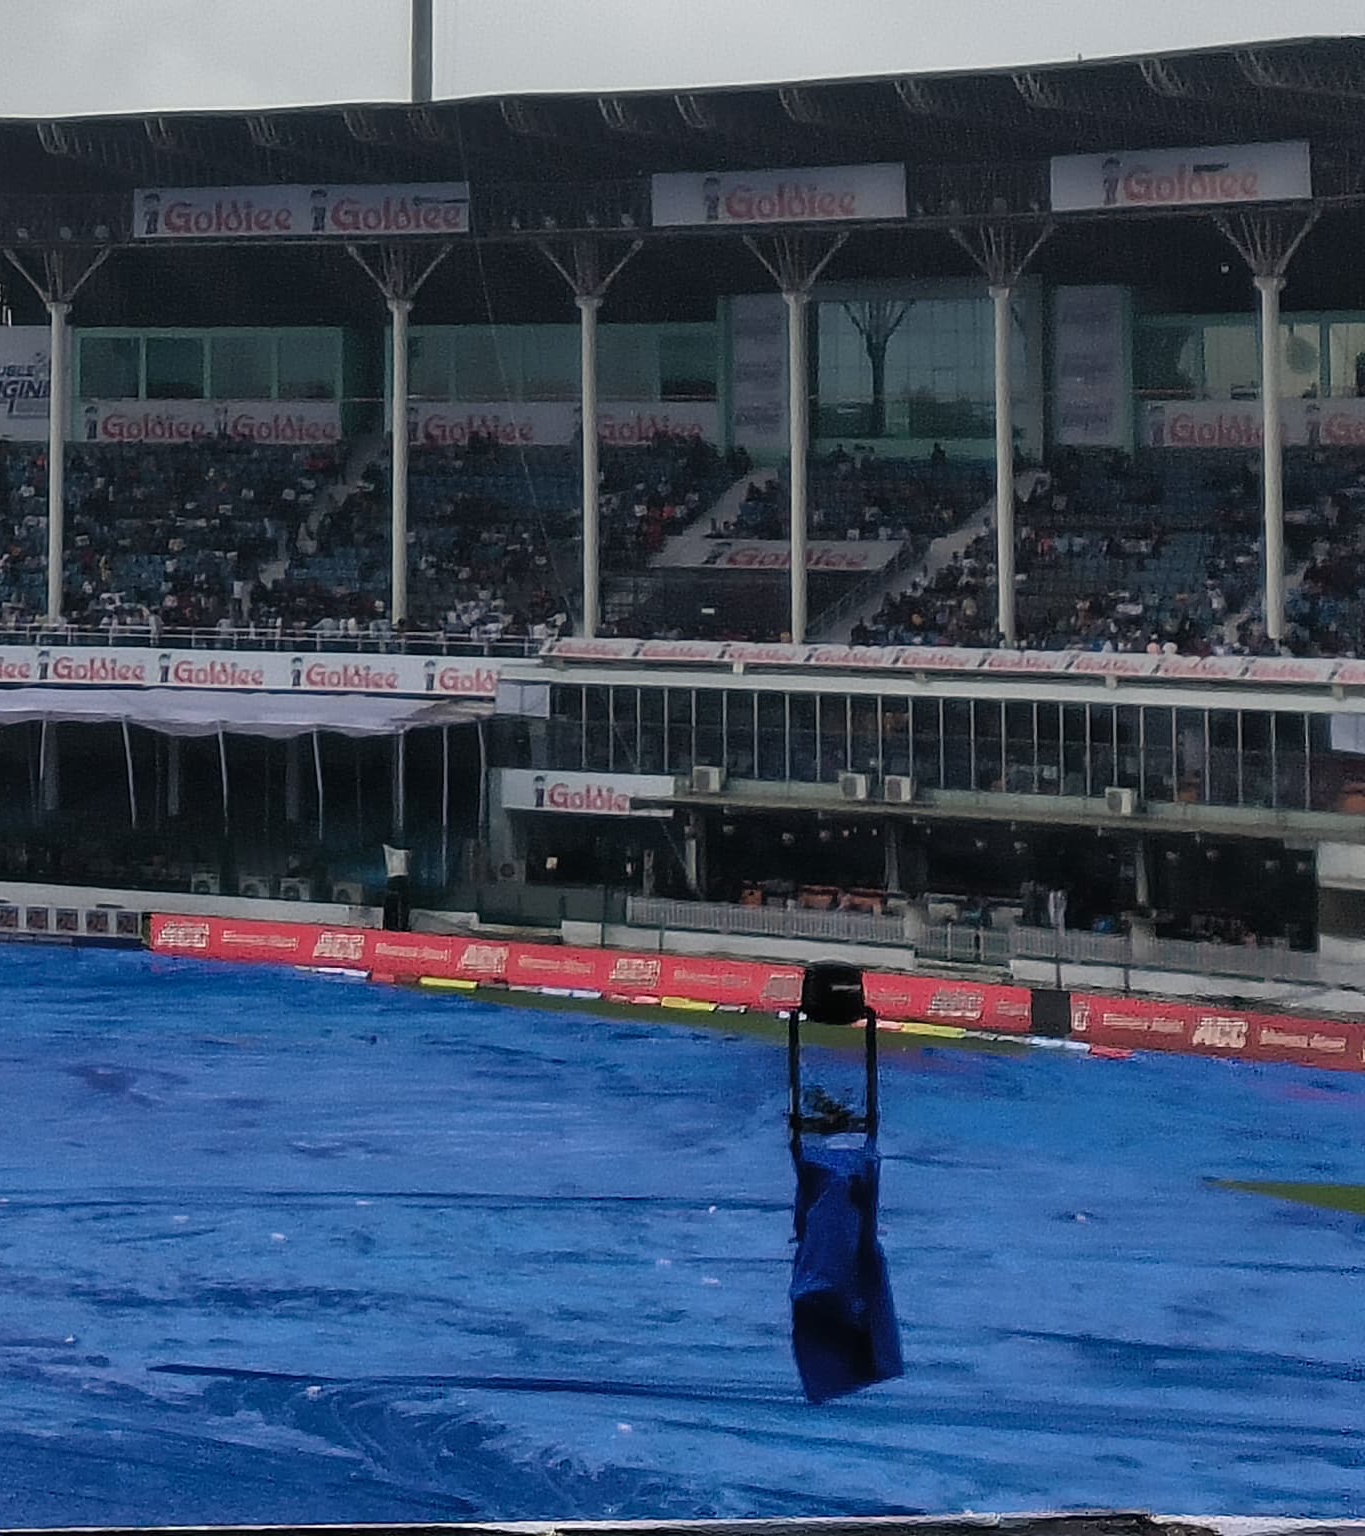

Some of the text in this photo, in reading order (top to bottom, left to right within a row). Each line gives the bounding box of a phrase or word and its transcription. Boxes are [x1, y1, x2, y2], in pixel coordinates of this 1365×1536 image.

[164, 196, 460, 233] Goldiee Goldiee
[725, 183, 855, 219] Goldiee
[101, 413, 205, 440] Goldiee
[53, 656, 145, 681] Goldiee
[173, 659, 263, 685] Goldiee
[306, 662, 398, 689] Goldiee
[439, 666, 501, 693] Gold
[549, 782, 630, 811] Goldie
